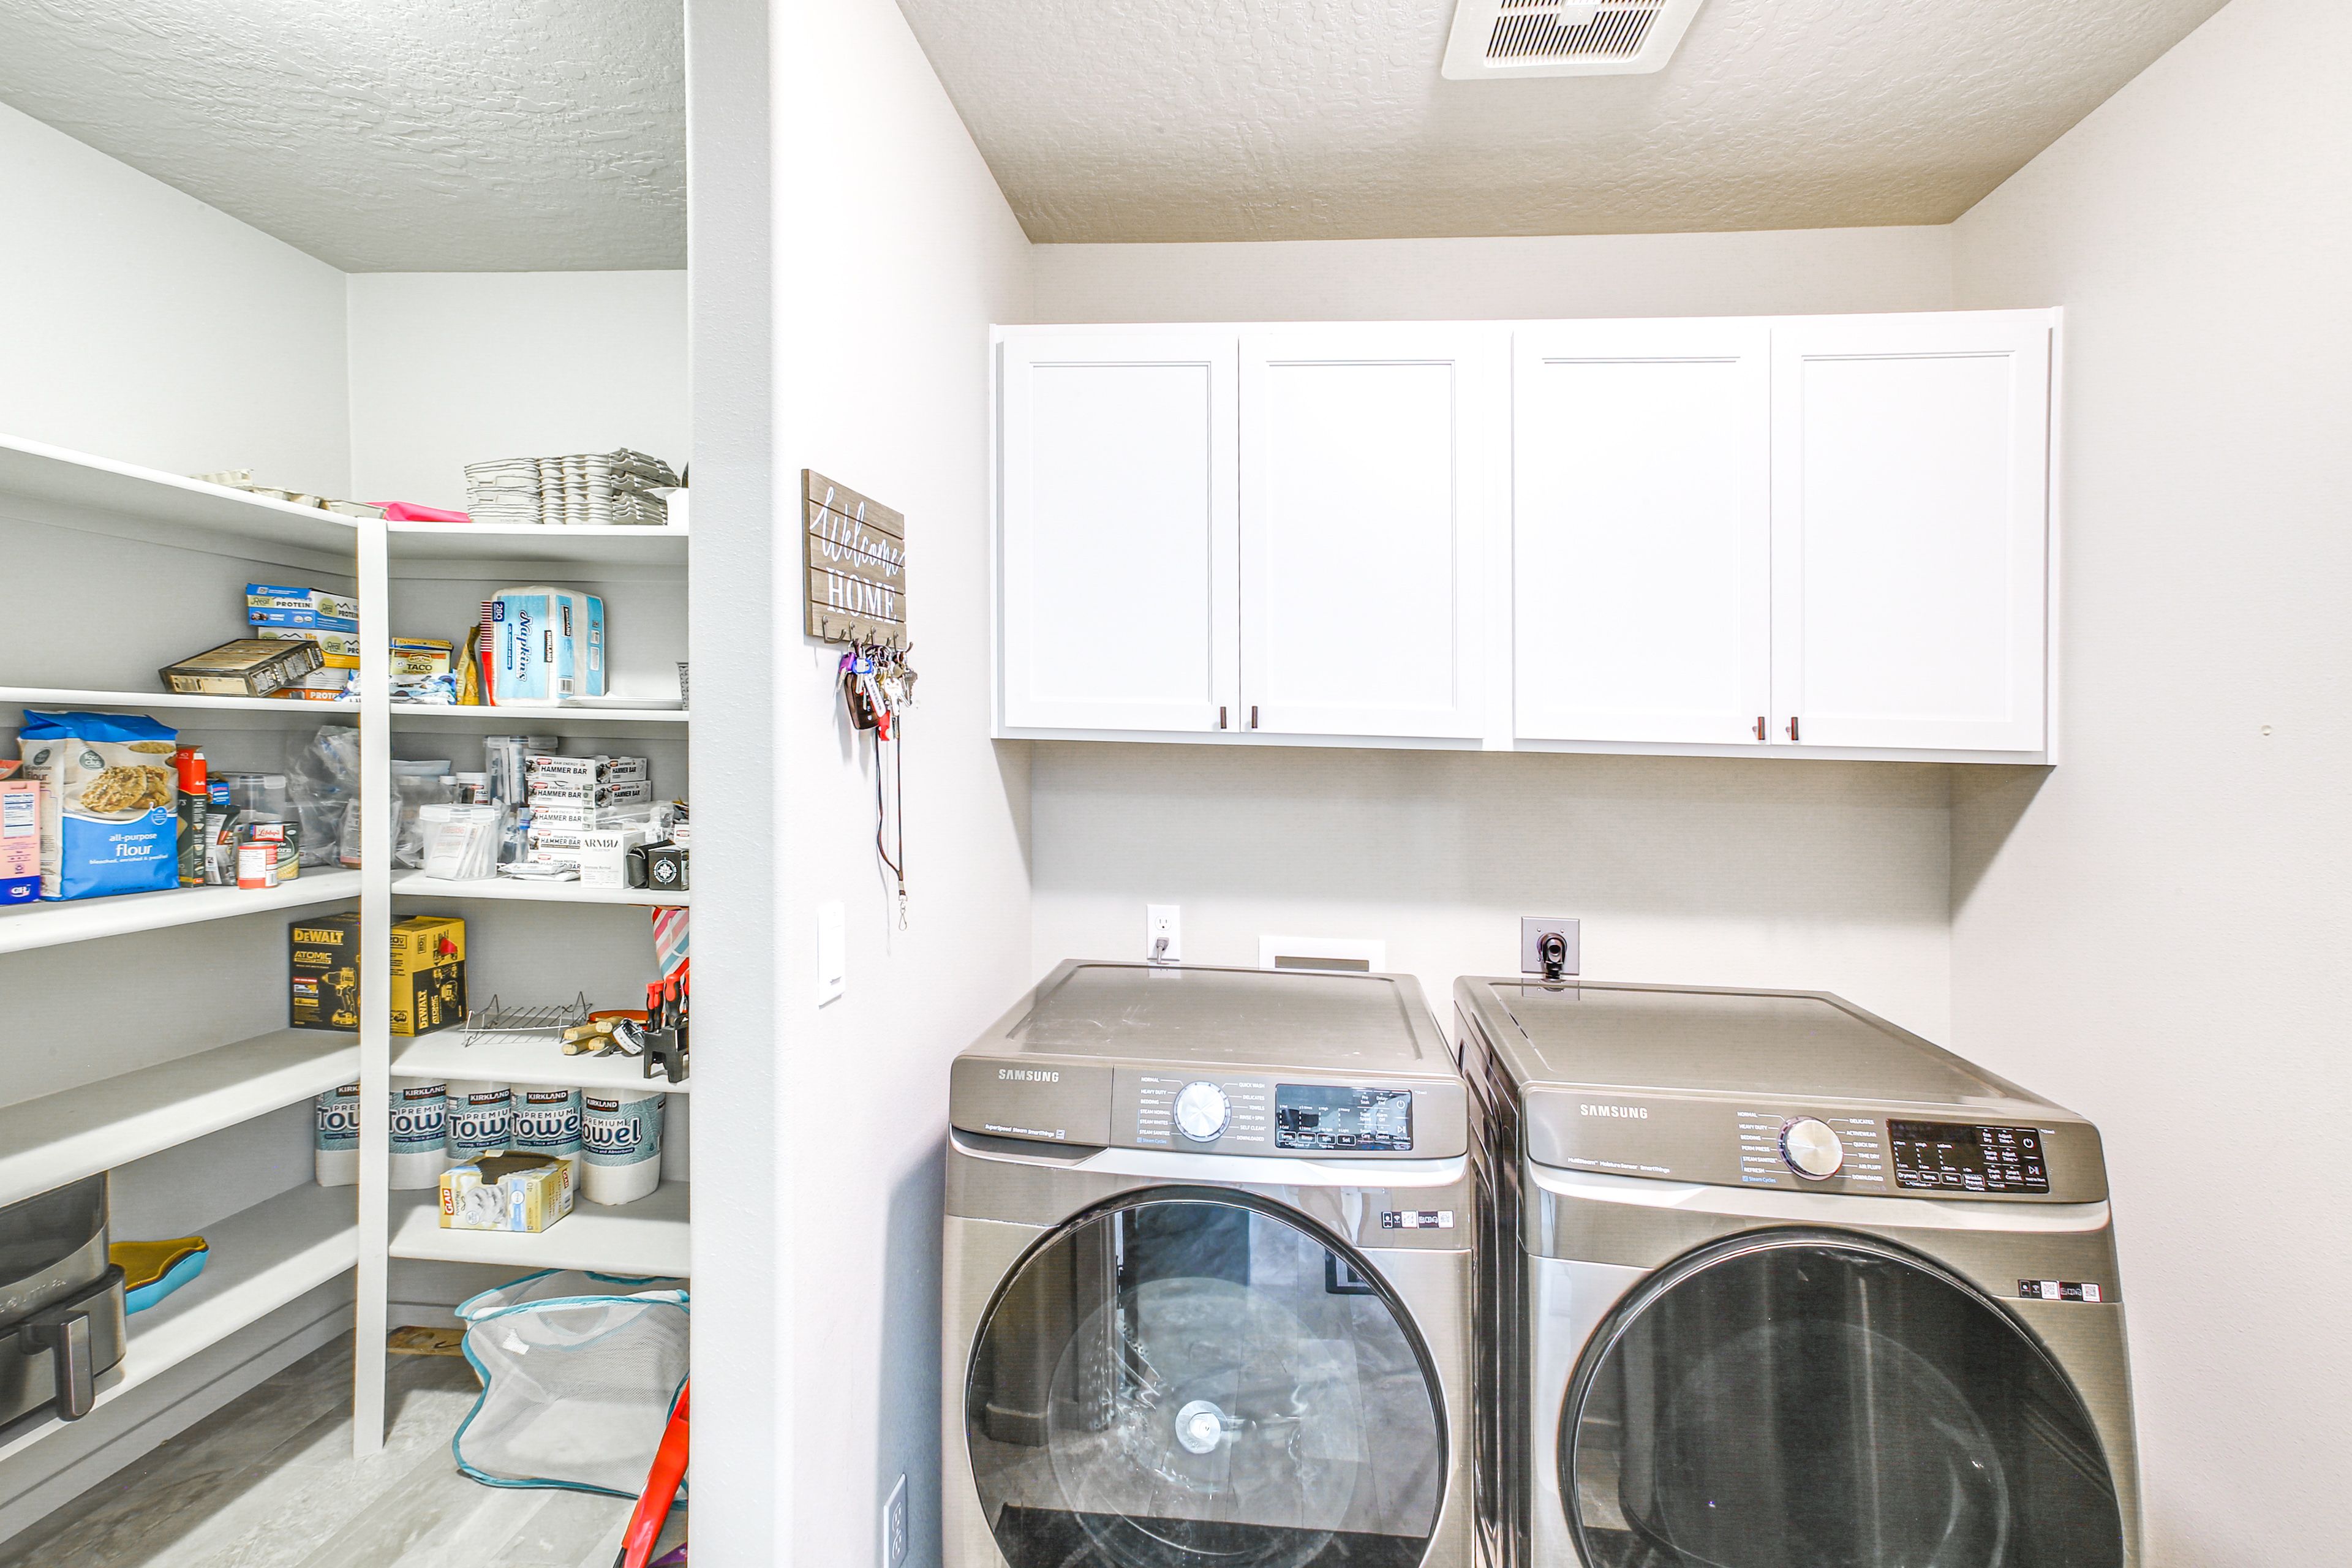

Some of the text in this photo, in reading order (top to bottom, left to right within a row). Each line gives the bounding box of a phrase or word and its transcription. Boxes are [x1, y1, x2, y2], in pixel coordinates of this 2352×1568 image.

[810, 486, 906, 578] Welcome
[826, 567, 897, 625] HOME
[515, 610, 532, 681] Napkins
[109, 834, 157, 842] all-purpose
[116, 843, 153, 857] flour
[295, 951, 332, 960] ATOMIC
[998, 1069, 1059, 1083] SAMSUNG
[405, 1086, 446, 1096] KIRKLAND
[470, 1091, 510, 1101] KIRKLAND
[587, 1099, 617, 1108] KIRKLAND
[467, 1109, 511, 1120] PREMIU
[525, 1109, 573, 1118] PREMIUM
[1580, 1104, 1648, 1119] SAMSUNG
[390, 1110, 447, 1133] Tow
[449, 1114, 511, 1137] Tow
[513, 1107, 582, 1137] Towel
[584, 1116, 624, 1126] PREMIUM
[1640, 1165, 1670, 1174] SmartThings
[527, 1182, 533, 1192] 40
[444, 1189, 454, 1214] GLAD
